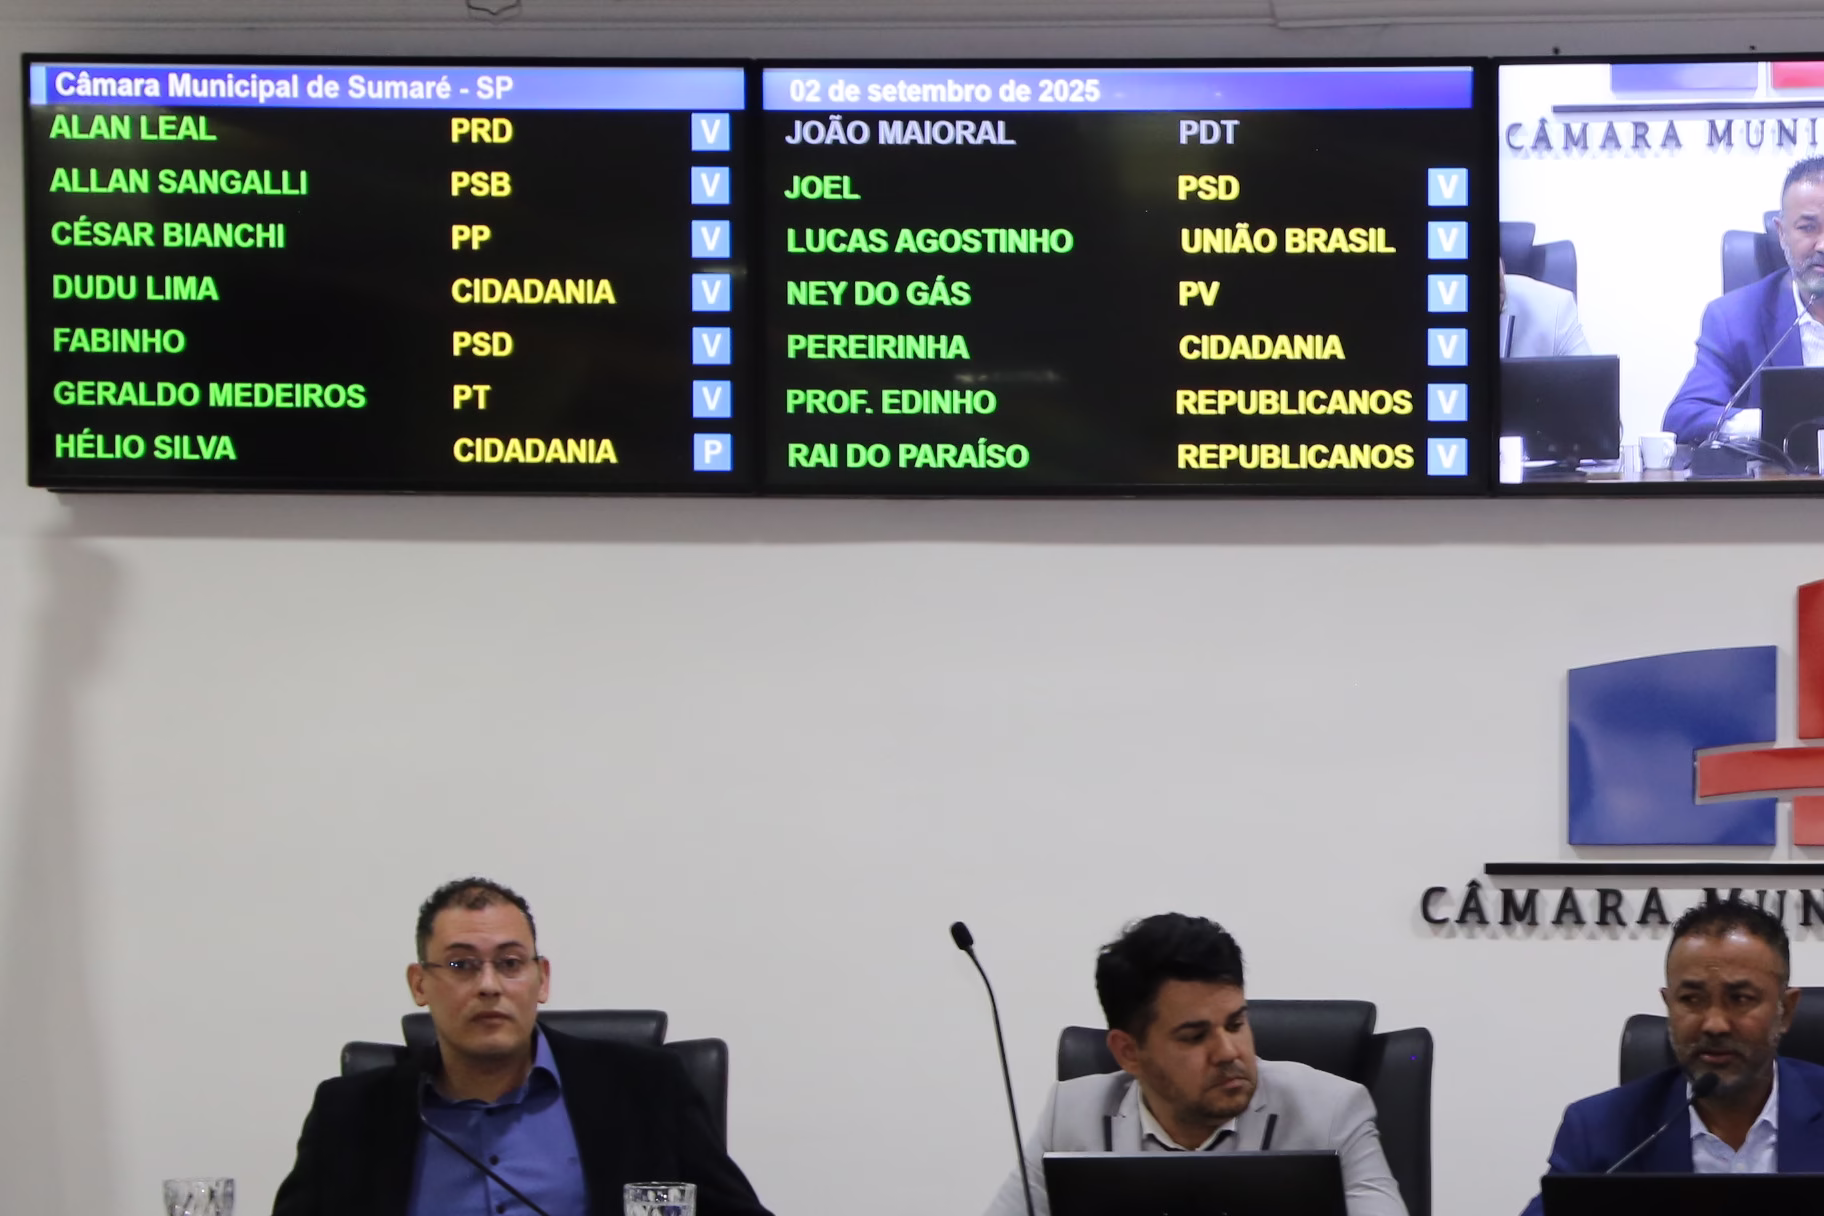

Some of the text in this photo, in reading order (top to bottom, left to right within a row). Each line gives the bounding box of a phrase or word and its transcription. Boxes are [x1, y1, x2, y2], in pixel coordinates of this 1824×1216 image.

[56, 72, 160, 97] Câmara
[169, 74, 298, 103] Municipal
[307, 75, 340, 98] de
[348, 75, 451, 99] Sumaré
[476, 76, 514, 100] SP
[790, 79, 1100, 102] 02 de setembro de 2025
[50, 115, 217, 141] ALAN LEAL
[452, 118, 513, 143] PRD
[701, 120, 720, 143] V
[785, 114, 1016, 145] JOÃO MAIORAL
[1179, 120, 1240, 145] PDT
[1505, 117, 1682, 150] CÂMARA
[50, 168, 307, 195] ALLAN SANGALLI
[451, 172, 511, 197] PSB
[701, 174, 720, 196] V
[784, 176, 861, 200] JOEL
[1178, 175, 1239, 200] PSD
[1438, 175, 1458, 198] V
[52, 216, 284, 248] CÉSAR BIANCHI
[452, 225, 490, 249] PP
[701, 227, 720, 250] V
[788, 229, 1073, 254] LUCAS AGOSTINHO
[1182, 223, 1396, 253] UNIÃO BRASIL
[1438, 228, 1458, 252] V
[53, 275, 219, 301] DUDU LIMA
[452, 278, 615, 304] CIDADANIA
[702, 280, 720, 304] V
[788, 275, 971, 306] NEY DO GÁS
[1179, 281, 1220, 306] PV
[1438, 281, 1458, 304] V
[54, 328, 185, 354] FABINHO
[453, 332, 513, 357] PSD
[702, 334, 721, 357] V
[788, 335, 970, 360] PEREIRINHA
[1179, 335, 1345, 360] CIDADANIA
[1438, 335, 1457, 358] V
[54, 381, 366, 409] GERALDO MEDEIROS
[453, 385, 491, 410] PT
[702, 387, 721, 410] V
[787, 390, 996, 414] PROF. EDINHO
[1177, 390, 1412, 415] REPUBLICANOS
[1438, 390, 1457, 414] V
[55, 430, 236, 460] HÉLIO SILVA
[453, 438, 617, 464] CIDADANIA
[705, 440, 722, 463] P
[789, 438, 1029, 469] RAI DO PARAÍSO
[1178, 444, 1414, 468] REPUBLICANOS
[1438, 444, 1457, 468] V
[1420, 879, 1669, 926] CÂMARA
